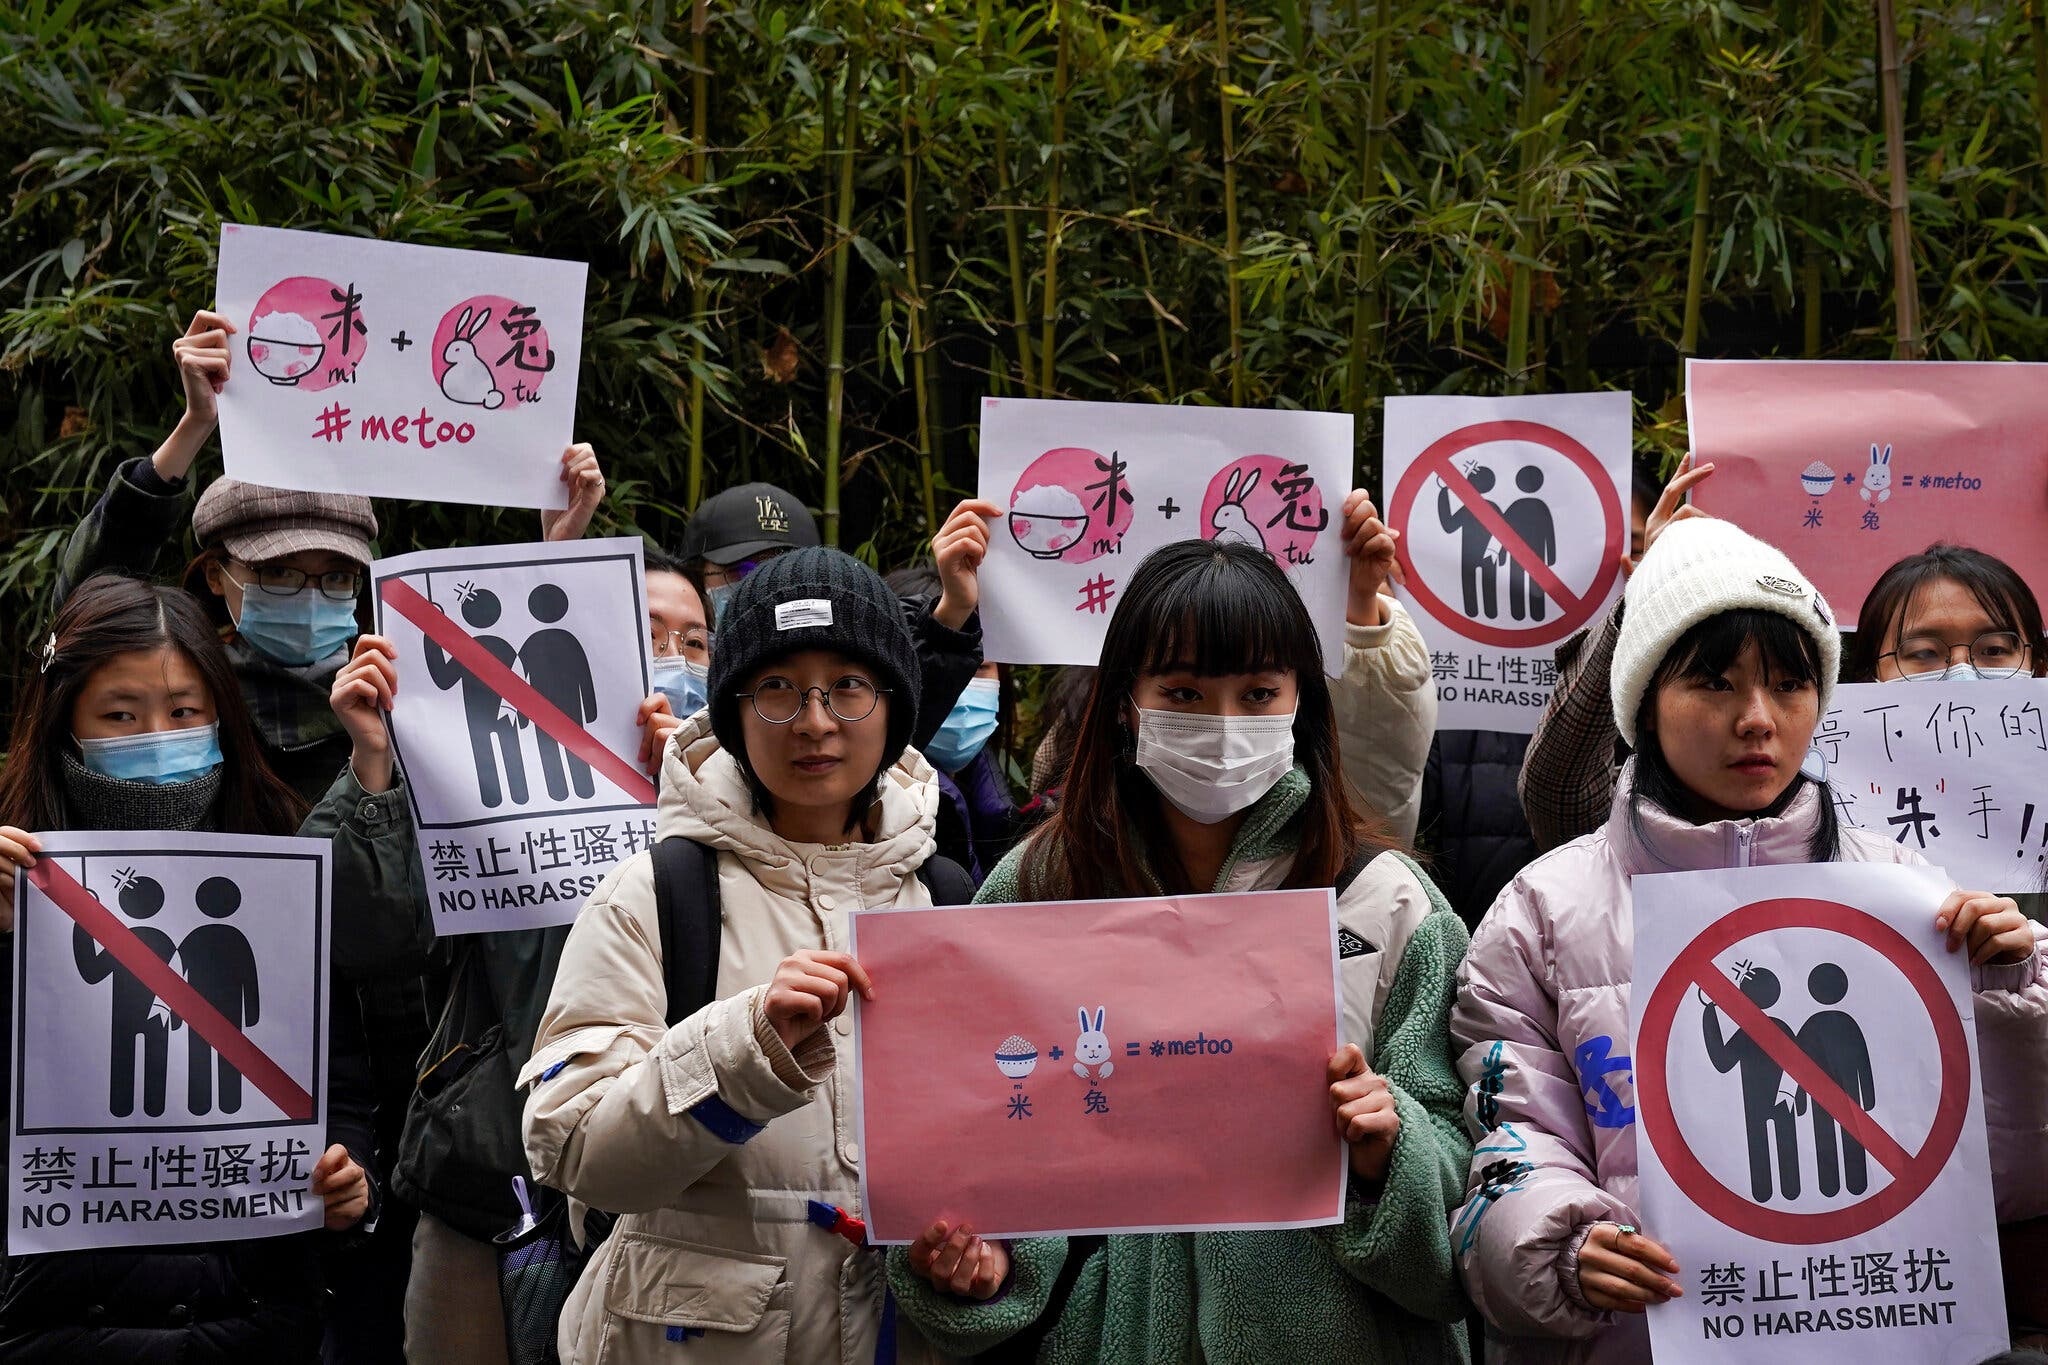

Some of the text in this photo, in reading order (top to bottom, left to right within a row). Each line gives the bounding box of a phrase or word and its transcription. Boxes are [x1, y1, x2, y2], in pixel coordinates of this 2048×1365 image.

[321, 283, 368, 356] 米
[496, 305, 555, 372] 兔
[328, 362, 357, 384] mi
[512, 380, 541, 403] tu
[312, 401, 476, 449] #metoo
[1085, 451, 1134, 527] 米
[1266, 464, 1329, 532] 兔
[1919, 471, 1982, 491] #metoo
[1803, 508, 1823, 529] 米
[1861, 510, 1880, 530] 兔
[1093, 533, 1122, 555] mi
[1283, 541, 1315, 564] tu
[438, 874, 605, 912] NO HARASS
[1149, 1032, 1233, 1057] #metoo
[1007, 1094, 1033, 1120] 米
[1083, 1089, 1110, 1115] 兔
[22, 1138, 310, 1195] 禁止性骚扰
[22, 1187, 308, 1229] NO HARASSMENT
[1700, 1247, 1954, 1307] 禁止性骚扰
[1703, 1301, 1957, 1339] NO HARASSMENT
